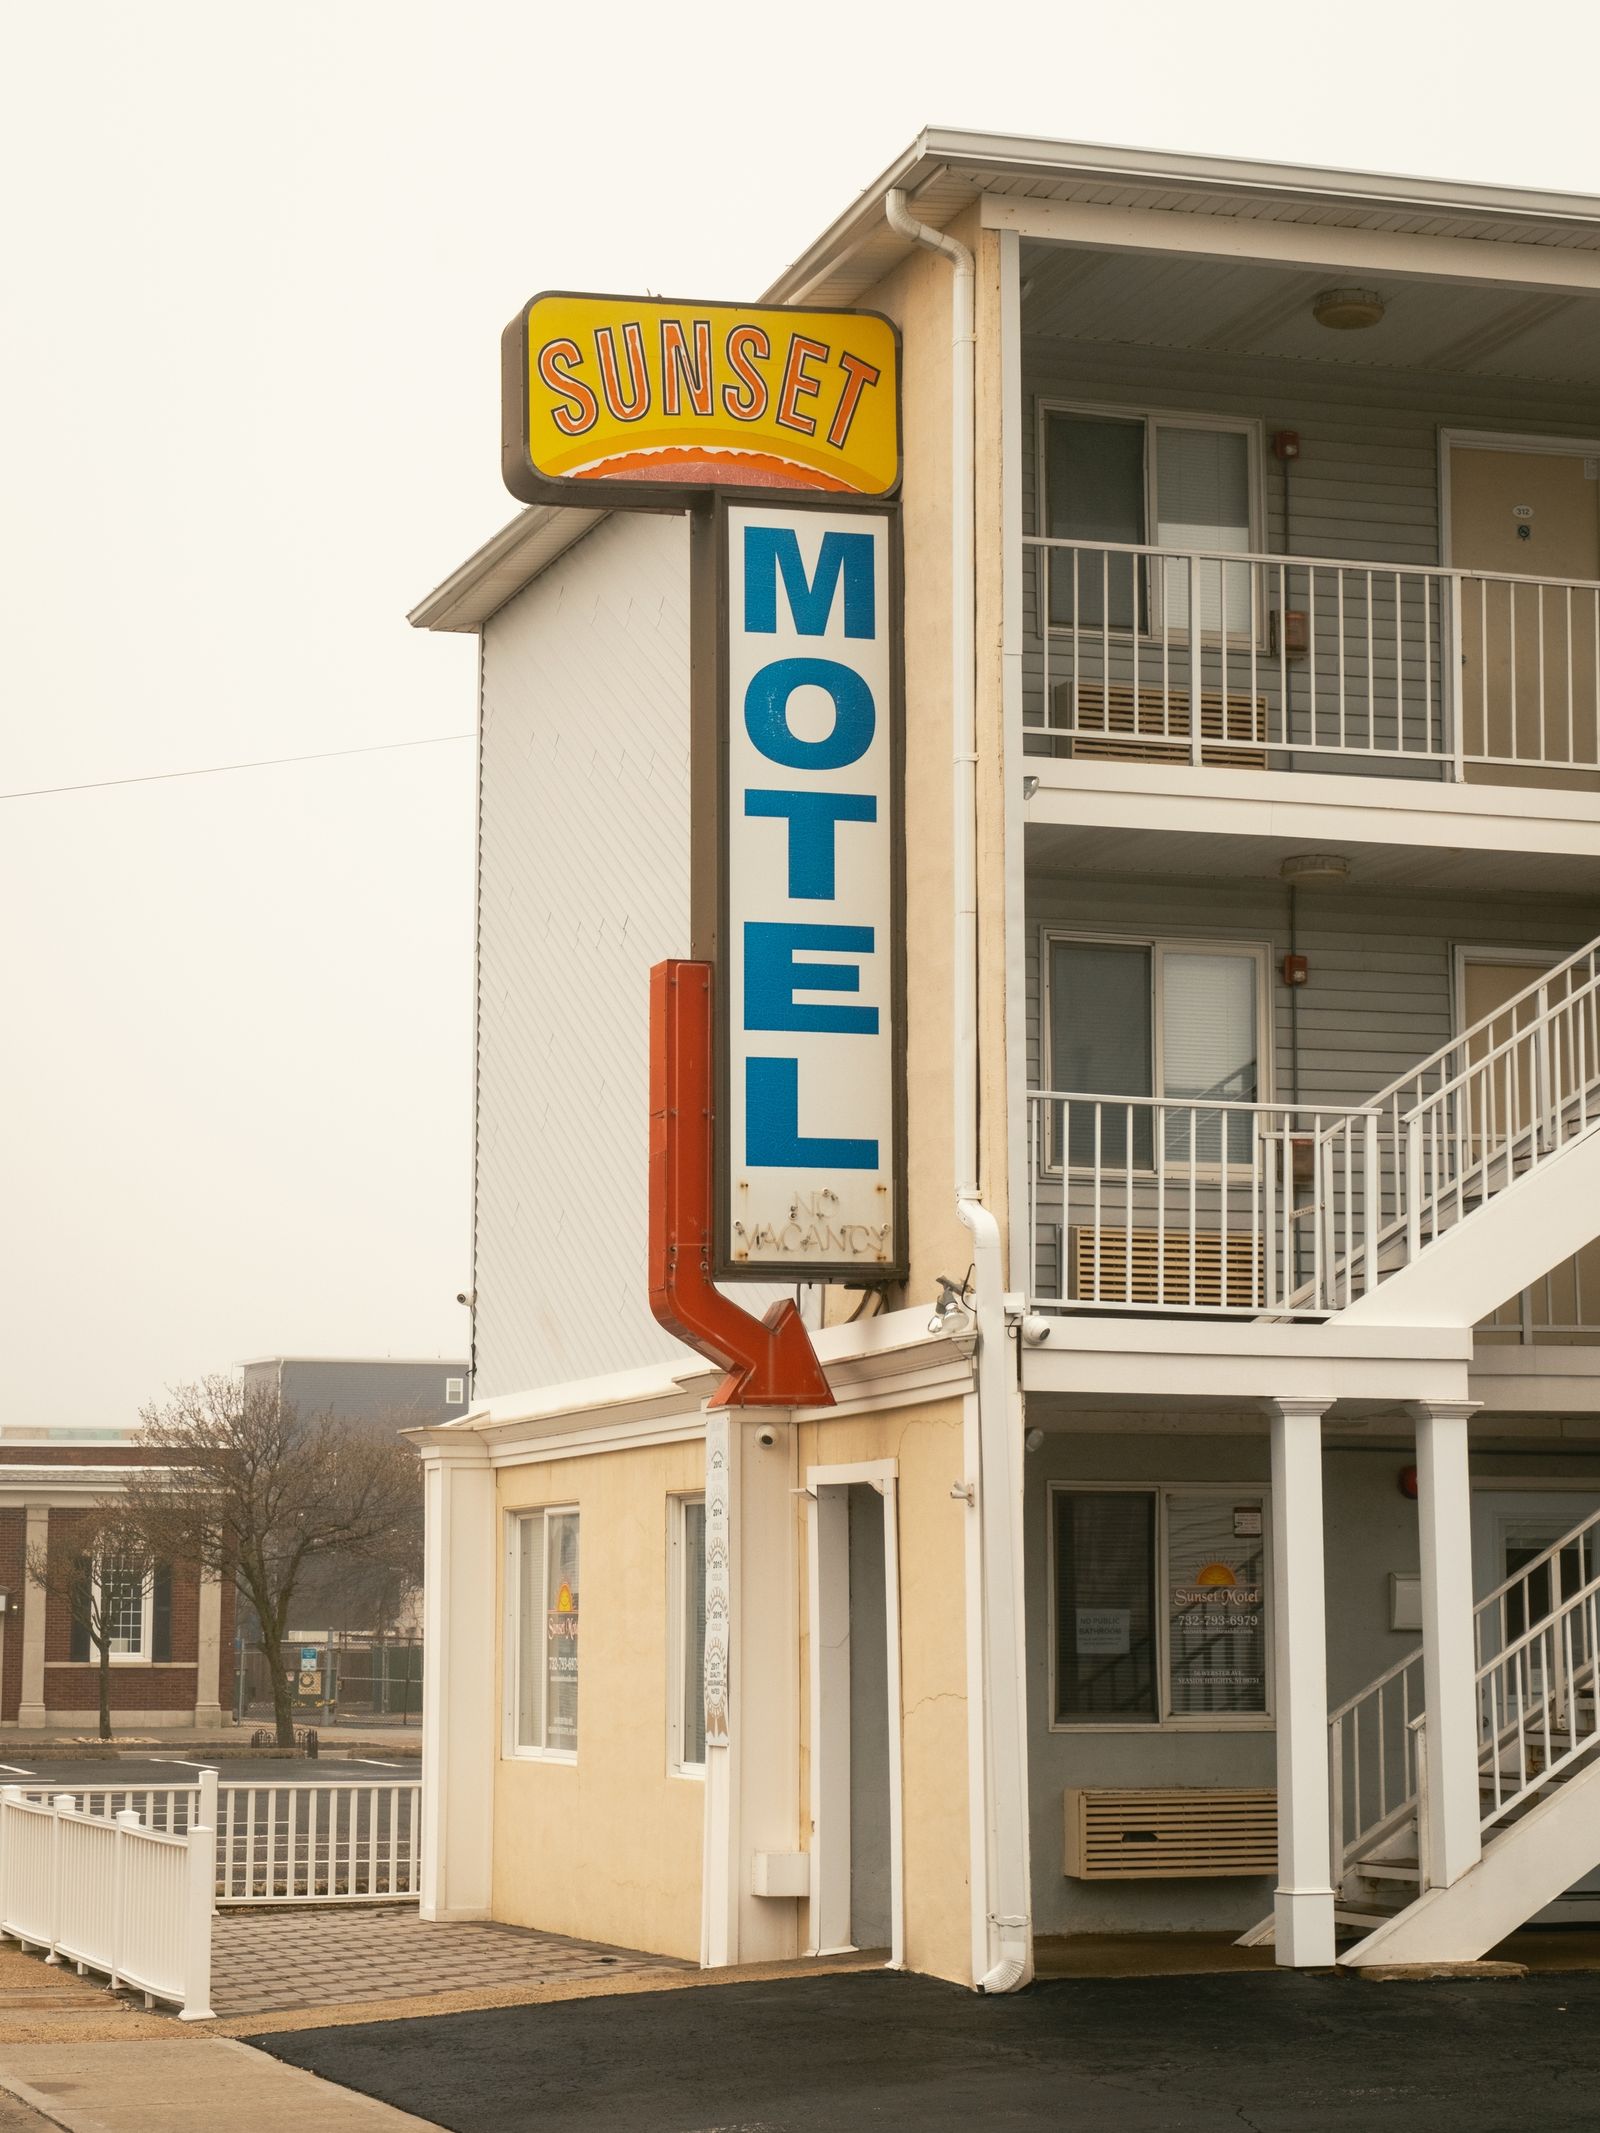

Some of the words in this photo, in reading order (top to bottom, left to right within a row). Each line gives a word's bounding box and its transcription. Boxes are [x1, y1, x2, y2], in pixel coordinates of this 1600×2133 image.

[537, 319, 882, 450] SUNSET
[1516, 507, 1530, 516] 312
[743, 525, 880, 1170] MOTEL
[792, 1189, 839, 1219] NO
[735, 1221, 889, 1254] VACANCY
[713, 1508, 722, 1517] 2014
[713, 1560, 722, 1569] 2015
[1173, 1589, 1218, 1606] Sunset
[1221, 1588, 1259, 1606] Motel
[713, 1611, 722, 1619] 2016
[1178, 1615, 1258, 1626] 732-793-6979
[1080, 1617, 1091, 1625] NO
[1093, 1617, 1120, 1625] PUBLIC
[548, 1617, 565, 1640] Sunset
[711, 1662, 720, 1671] 2017
